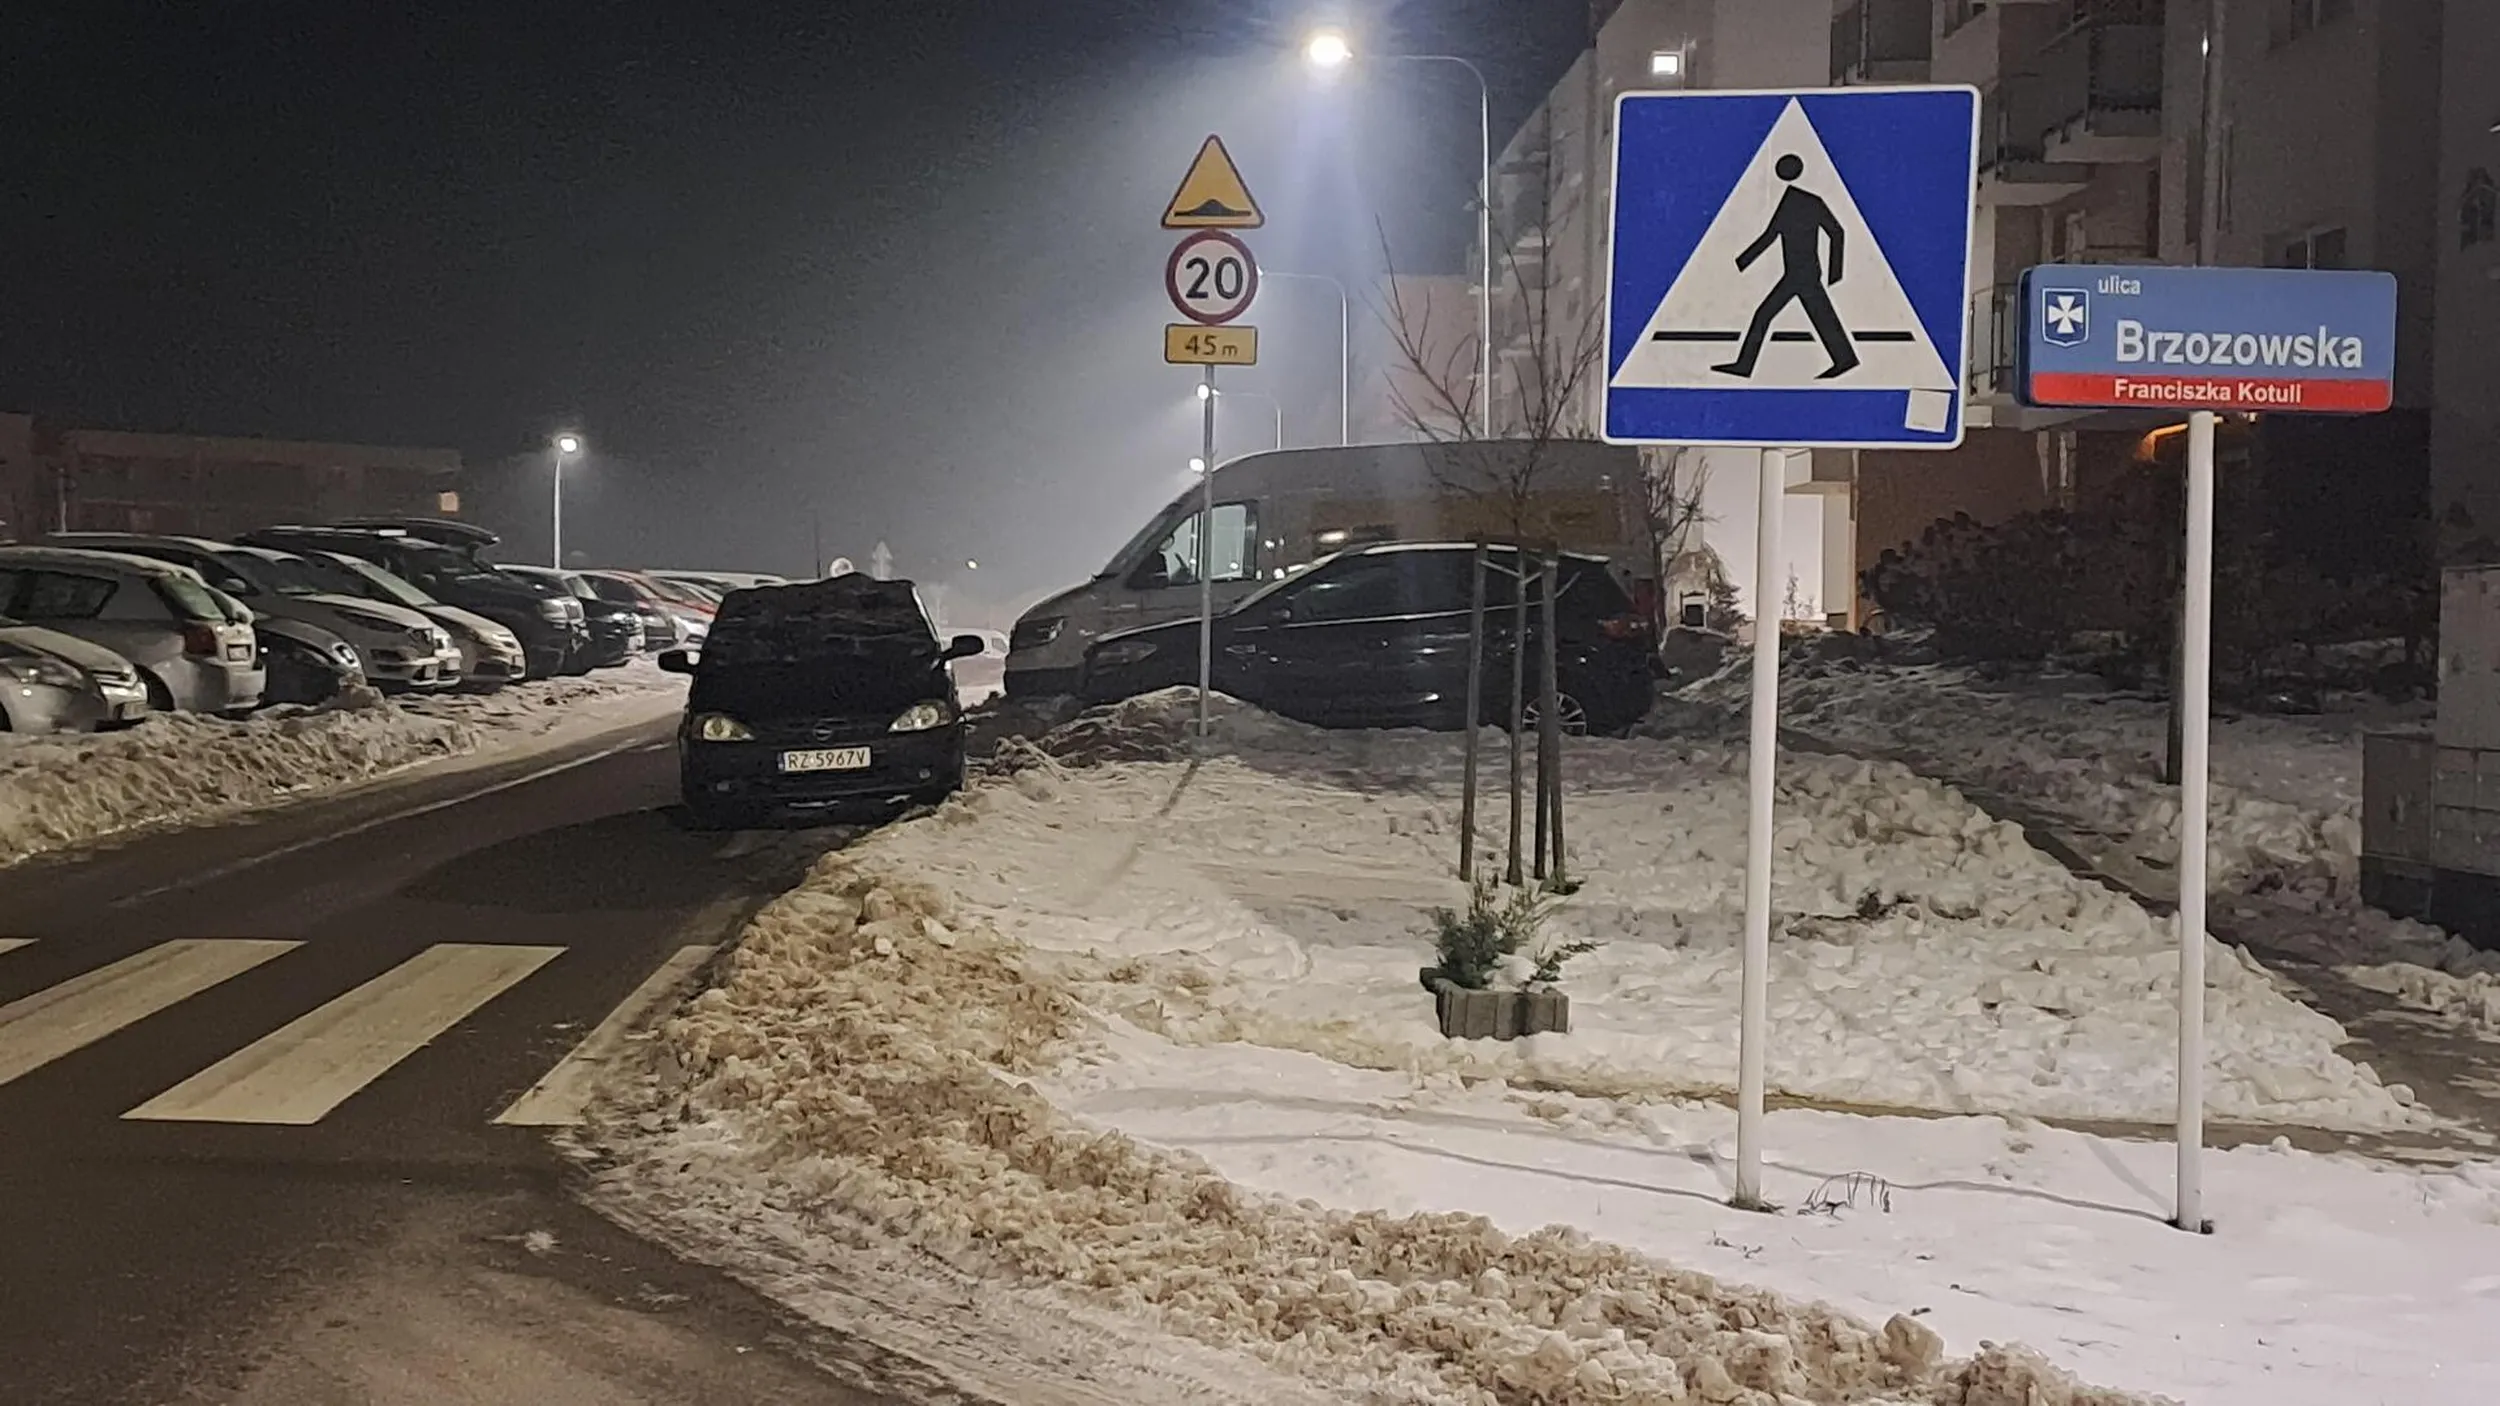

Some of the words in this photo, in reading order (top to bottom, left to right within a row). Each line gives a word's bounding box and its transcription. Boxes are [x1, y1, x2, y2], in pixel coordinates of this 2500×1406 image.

[1185, 256, 1243, 299] 20
[2098, 275, 2141, 295] ulica
[1185, 335, 1217, 356] 45
[1222, 345, 1238, 357] m
[2116, 319, 2364, 369] Brzozowska
[2113, 378, 2232, 401] Franciszka
[2237, 381, 2302, 404] Kotuli
[788, 753, 809, 769] RZ
[815, 750, 865, 768] 5967V
